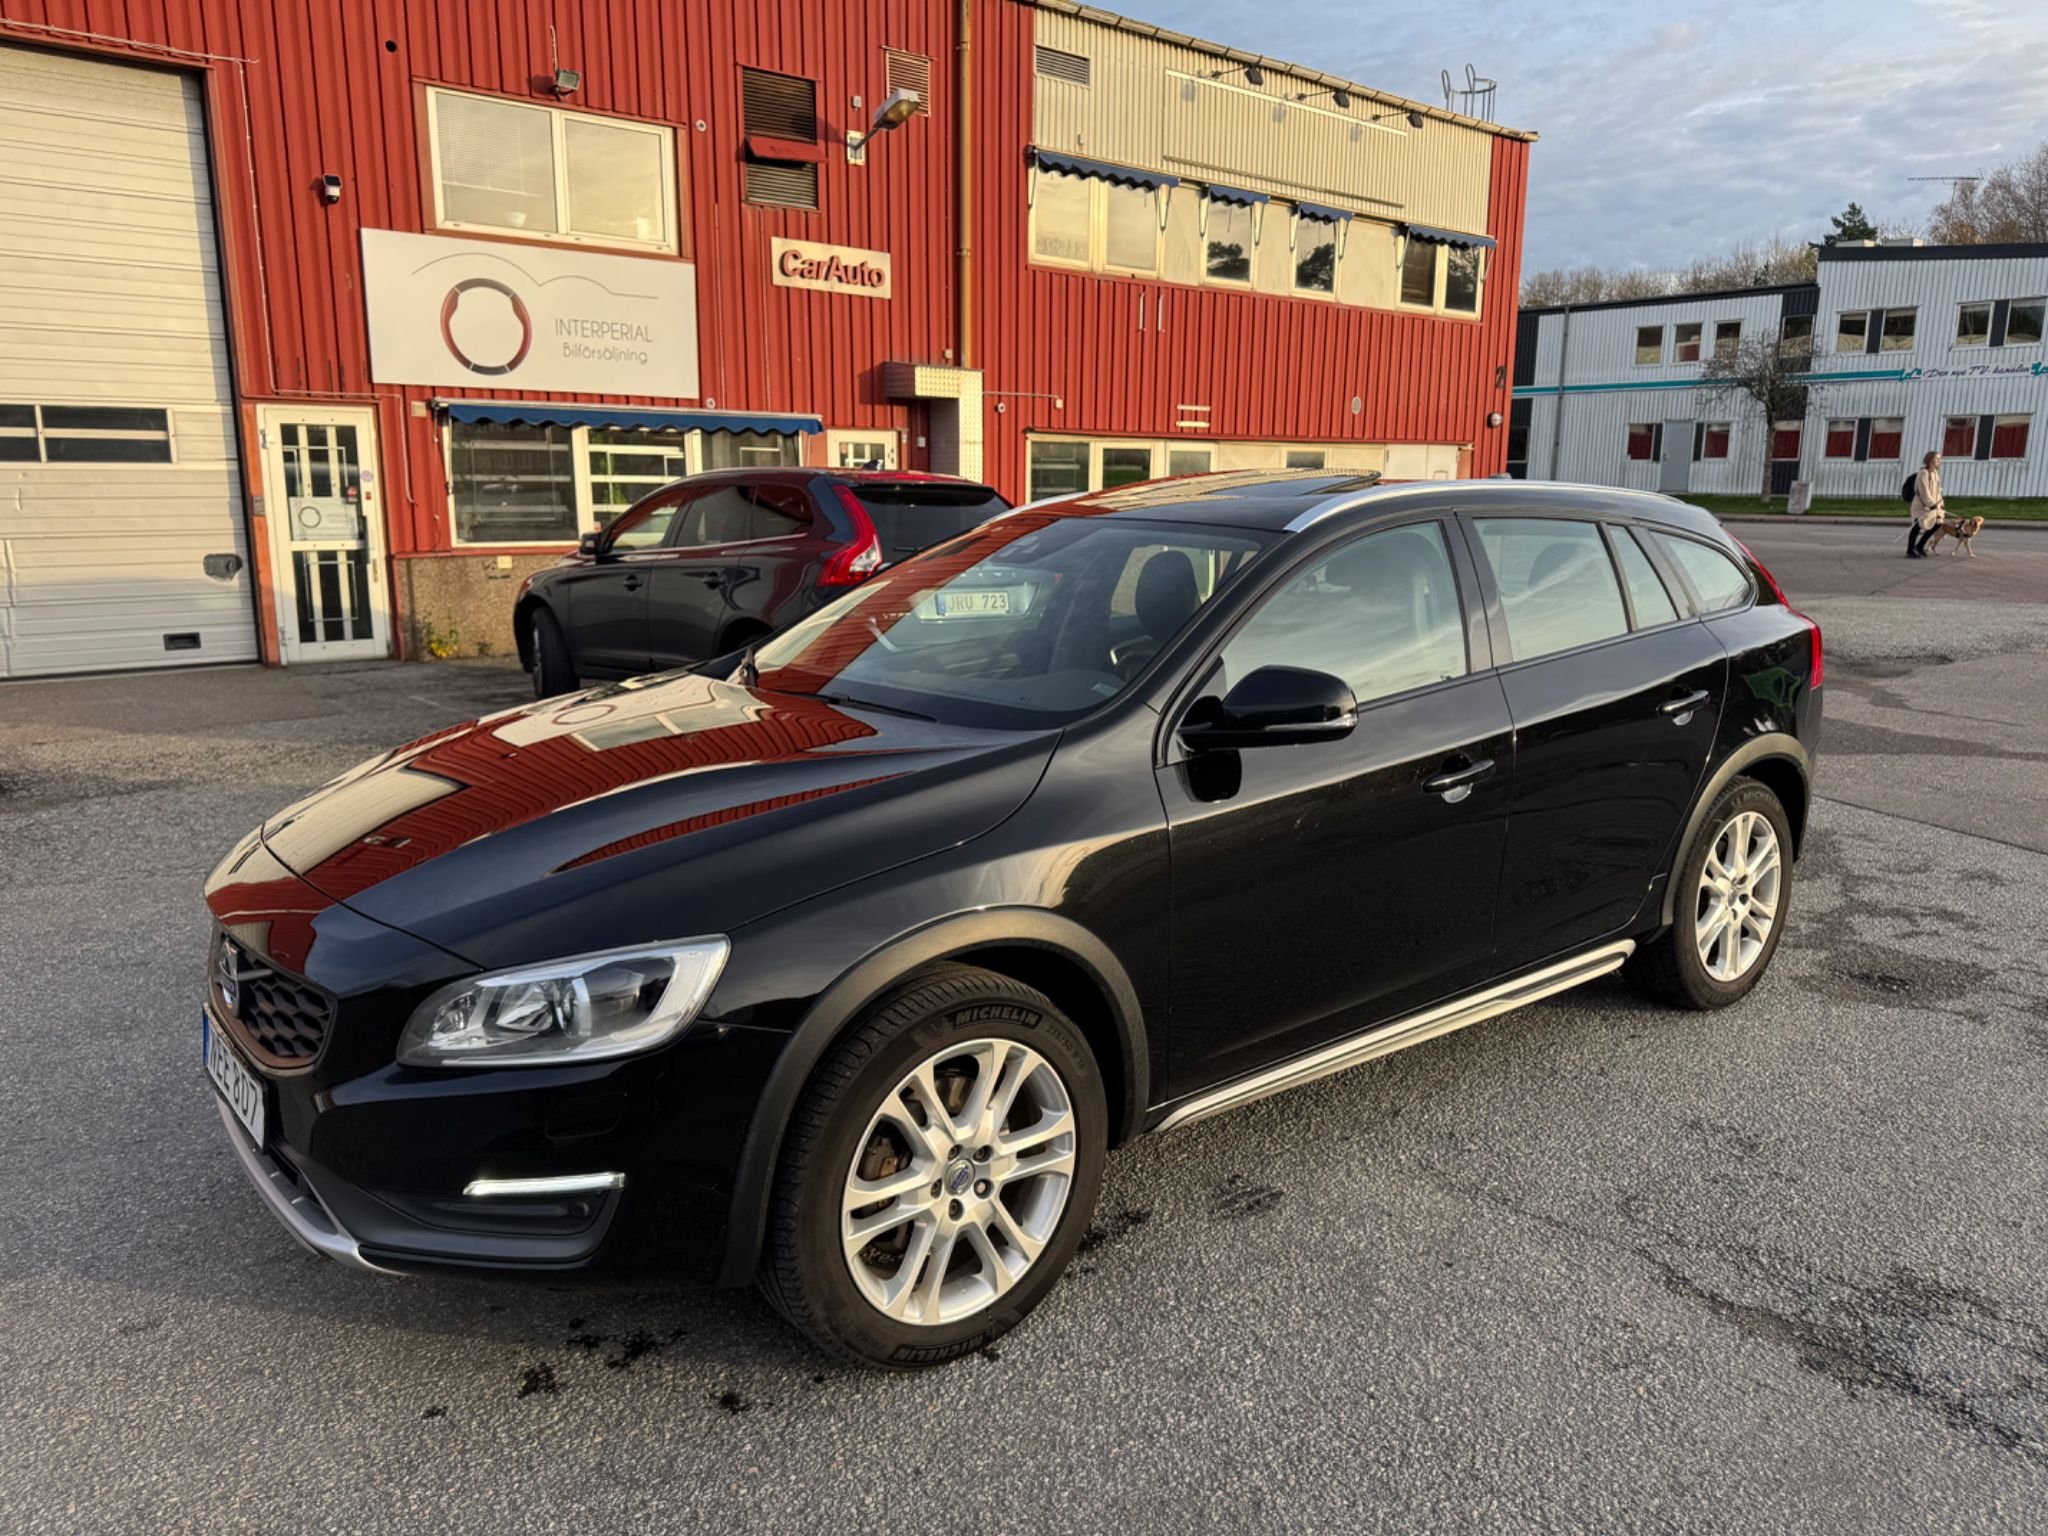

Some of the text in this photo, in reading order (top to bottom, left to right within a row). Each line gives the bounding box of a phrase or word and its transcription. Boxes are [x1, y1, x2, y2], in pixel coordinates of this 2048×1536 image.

[779, 249, 886, 288] CarAuto
[555, 318, 653, 343] INTERPERIAL
[563, 341, 648, 365] Bilförsäljning
[949, 594, 1007, 611] JRU 723
[956, 1005, 1040, 1026] MICHELIN
[209, 1026, 231, 1094] NEE
[233, 1060, 258, 1127] 807
